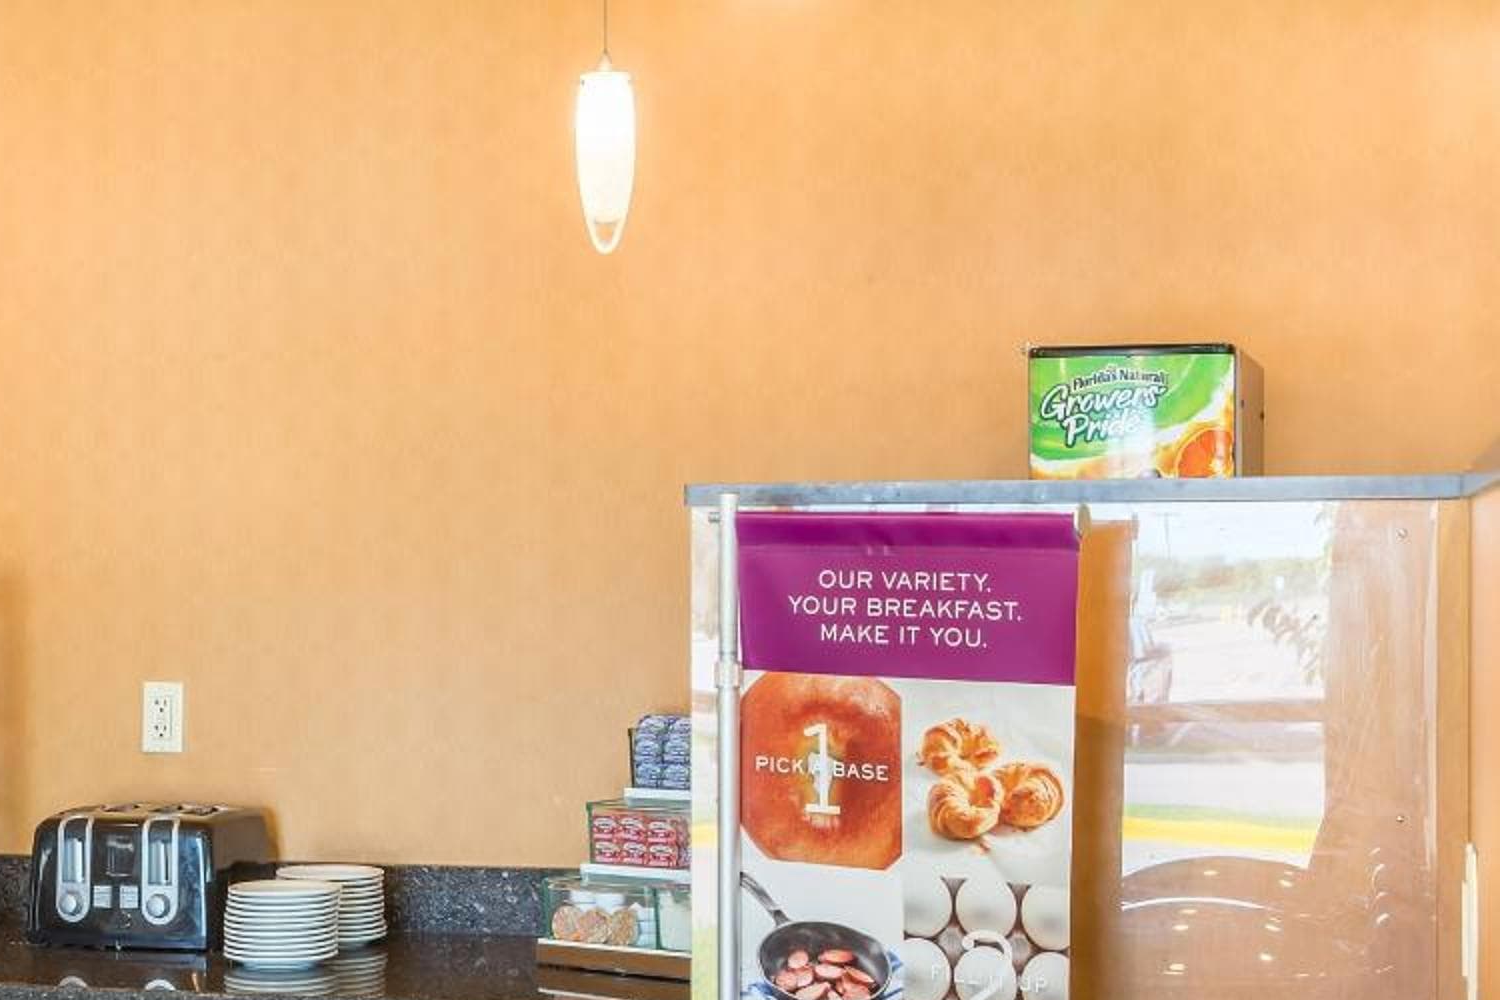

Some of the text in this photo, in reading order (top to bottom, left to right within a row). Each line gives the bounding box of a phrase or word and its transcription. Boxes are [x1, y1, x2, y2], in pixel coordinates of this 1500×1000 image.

[1062, 408, 1141, 447] Pride
[818, 569, 992, 593] OUR VARIETY.
[788, 595, 1022, 621] YOUR BREAKFAST.
[820, 623, 988, 649] MAKE IT YOU.
[755, 755, 804, 775] PICK
[833, 761, 889, 782] BASE
[803, 723, 841, 815] 1
